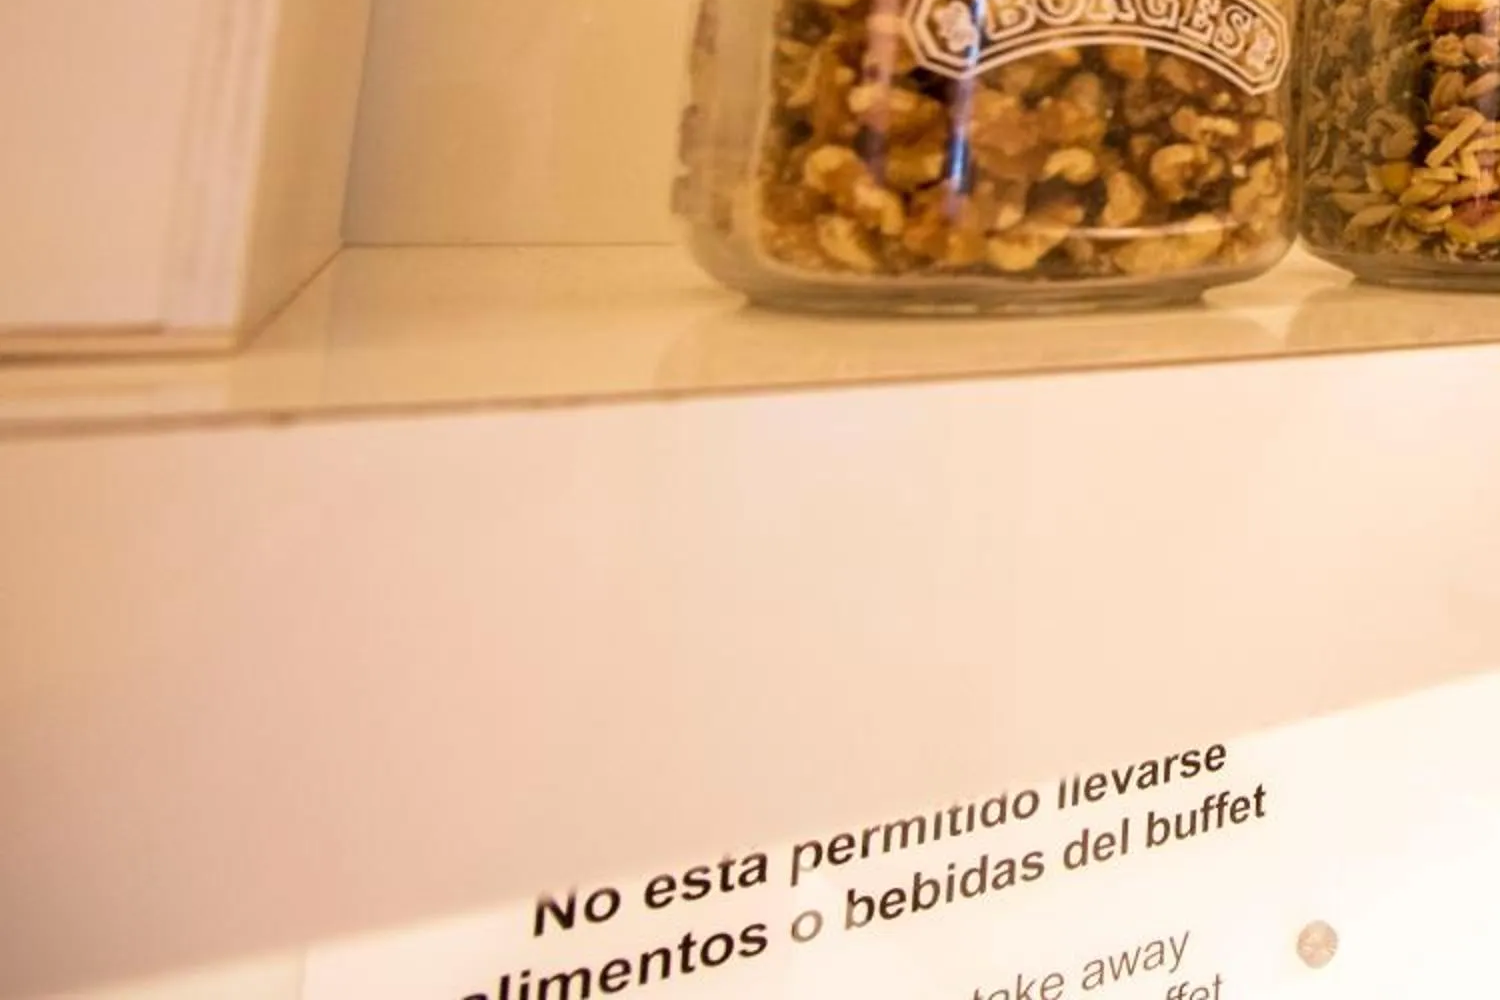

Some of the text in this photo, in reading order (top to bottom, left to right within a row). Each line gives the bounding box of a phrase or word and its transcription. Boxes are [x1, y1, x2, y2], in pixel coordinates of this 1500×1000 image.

[460, 783, 1266, 1000] limentos o bebidas del buffet
[533, 744, 1226, 937] No esta permitido llevarse
[1081, 930, 1190, 991] away
